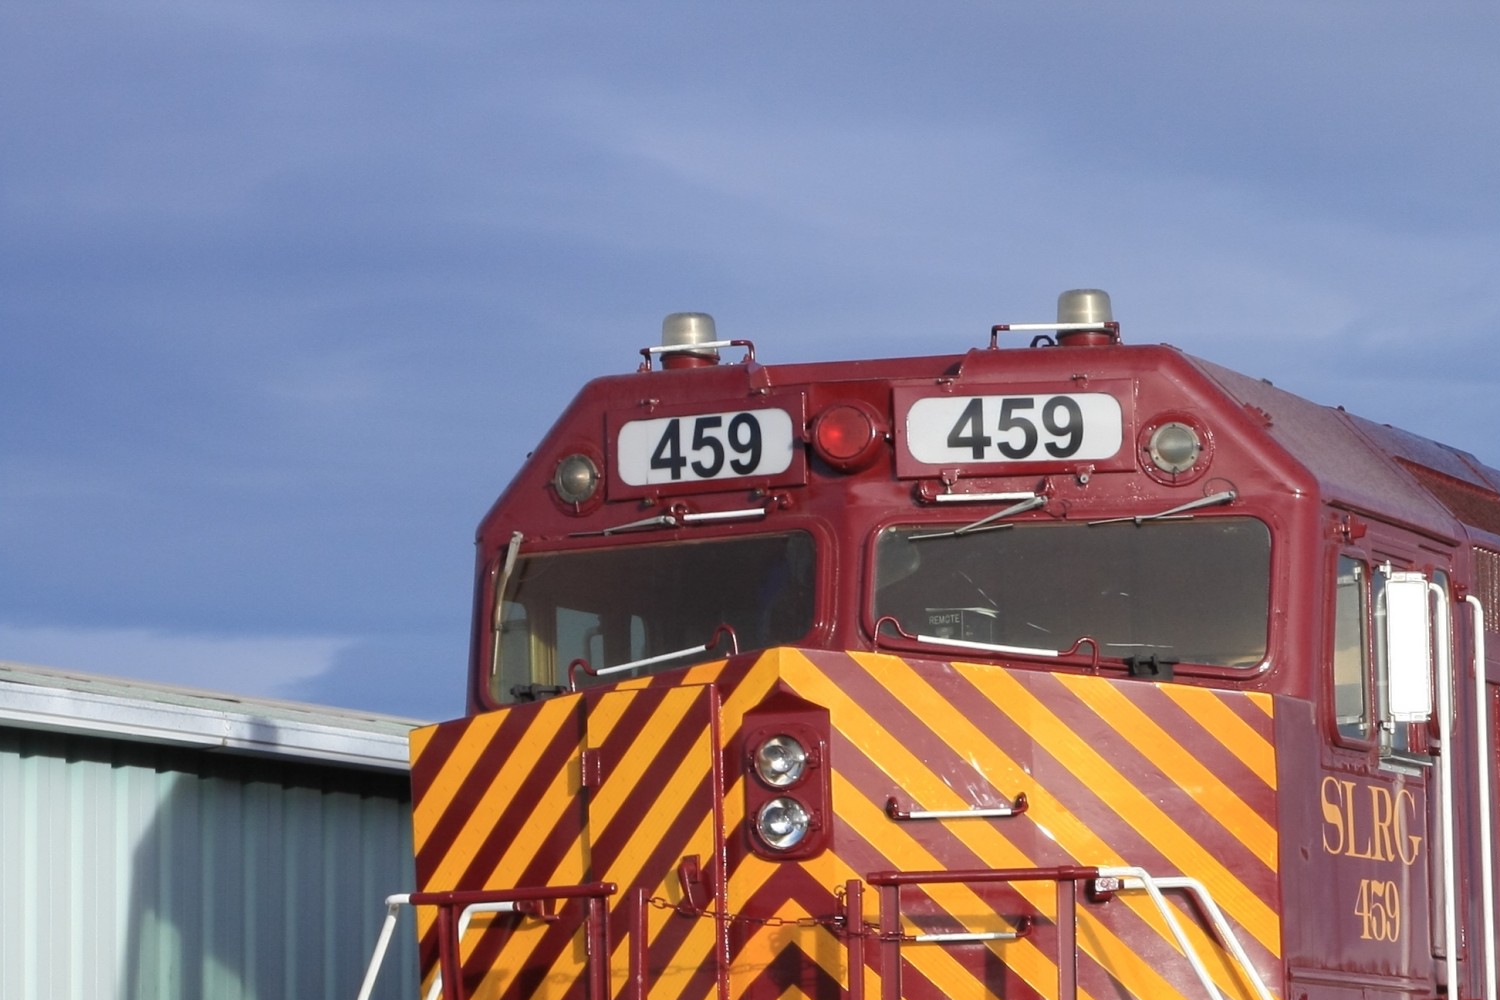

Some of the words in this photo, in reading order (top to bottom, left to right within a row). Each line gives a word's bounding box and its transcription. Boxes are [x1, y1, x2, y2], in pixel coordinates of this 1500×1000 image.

[650, 412, 763, 481] 459
[946, 394, 1085, 460] 459
[928, 613, 961, 625] REMOTE
[1320, 776, 1423, 866] SLRG
[1354, 878, 1400, 943] 459
